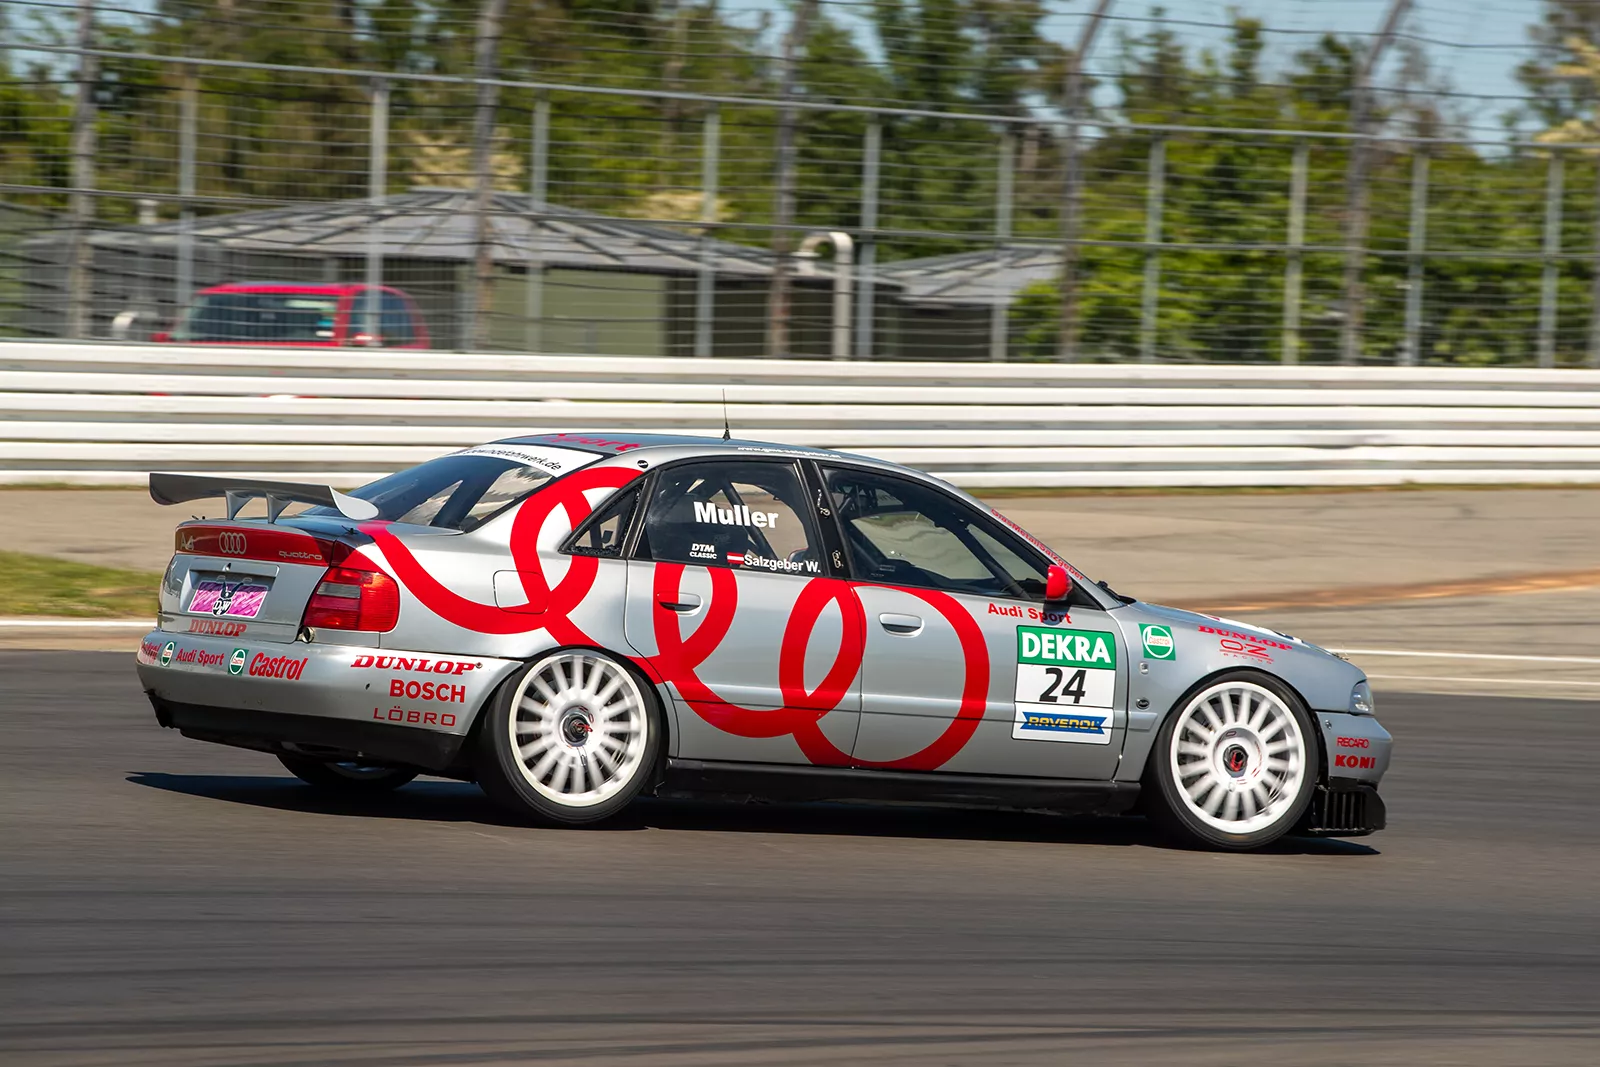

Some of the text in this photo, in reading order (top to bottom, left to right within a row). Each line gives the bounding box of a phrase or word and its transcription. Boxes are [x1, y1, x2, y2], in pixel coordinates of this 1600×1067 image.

[693, 501, 779, 529] Muller
[278, 550, 323, 561] quattro
[689, 551, 718, 560] CLASSIC
[691, 543, 715, 553] DTM
[743, 554, 821, 573] Salzgeber W.
[988, 602, 1072, 625] Audi Sport
[189, 618, 247, 637] DUNLOP
[1021, 632, 1112, 663] DEKRA
[1198, 625, 1293, 651] DUNLOP
[176, 648, 197, 662] Audi
[199, 650, 225, 667] Sport
[249, 652, 308, 680] Castrol
[350, 655, 476, 675] DUNLOP
[389, 679, 466, 703] BOSCH
[1039, 667, 1087, 704] 24
[373, 706, 457, 727] LÖBRO
[1028, 716, 1099, 731] RAVENOL
[1336, 736, 1370, 749] RECARO
[1335, 754, 1376, 769] KONI
